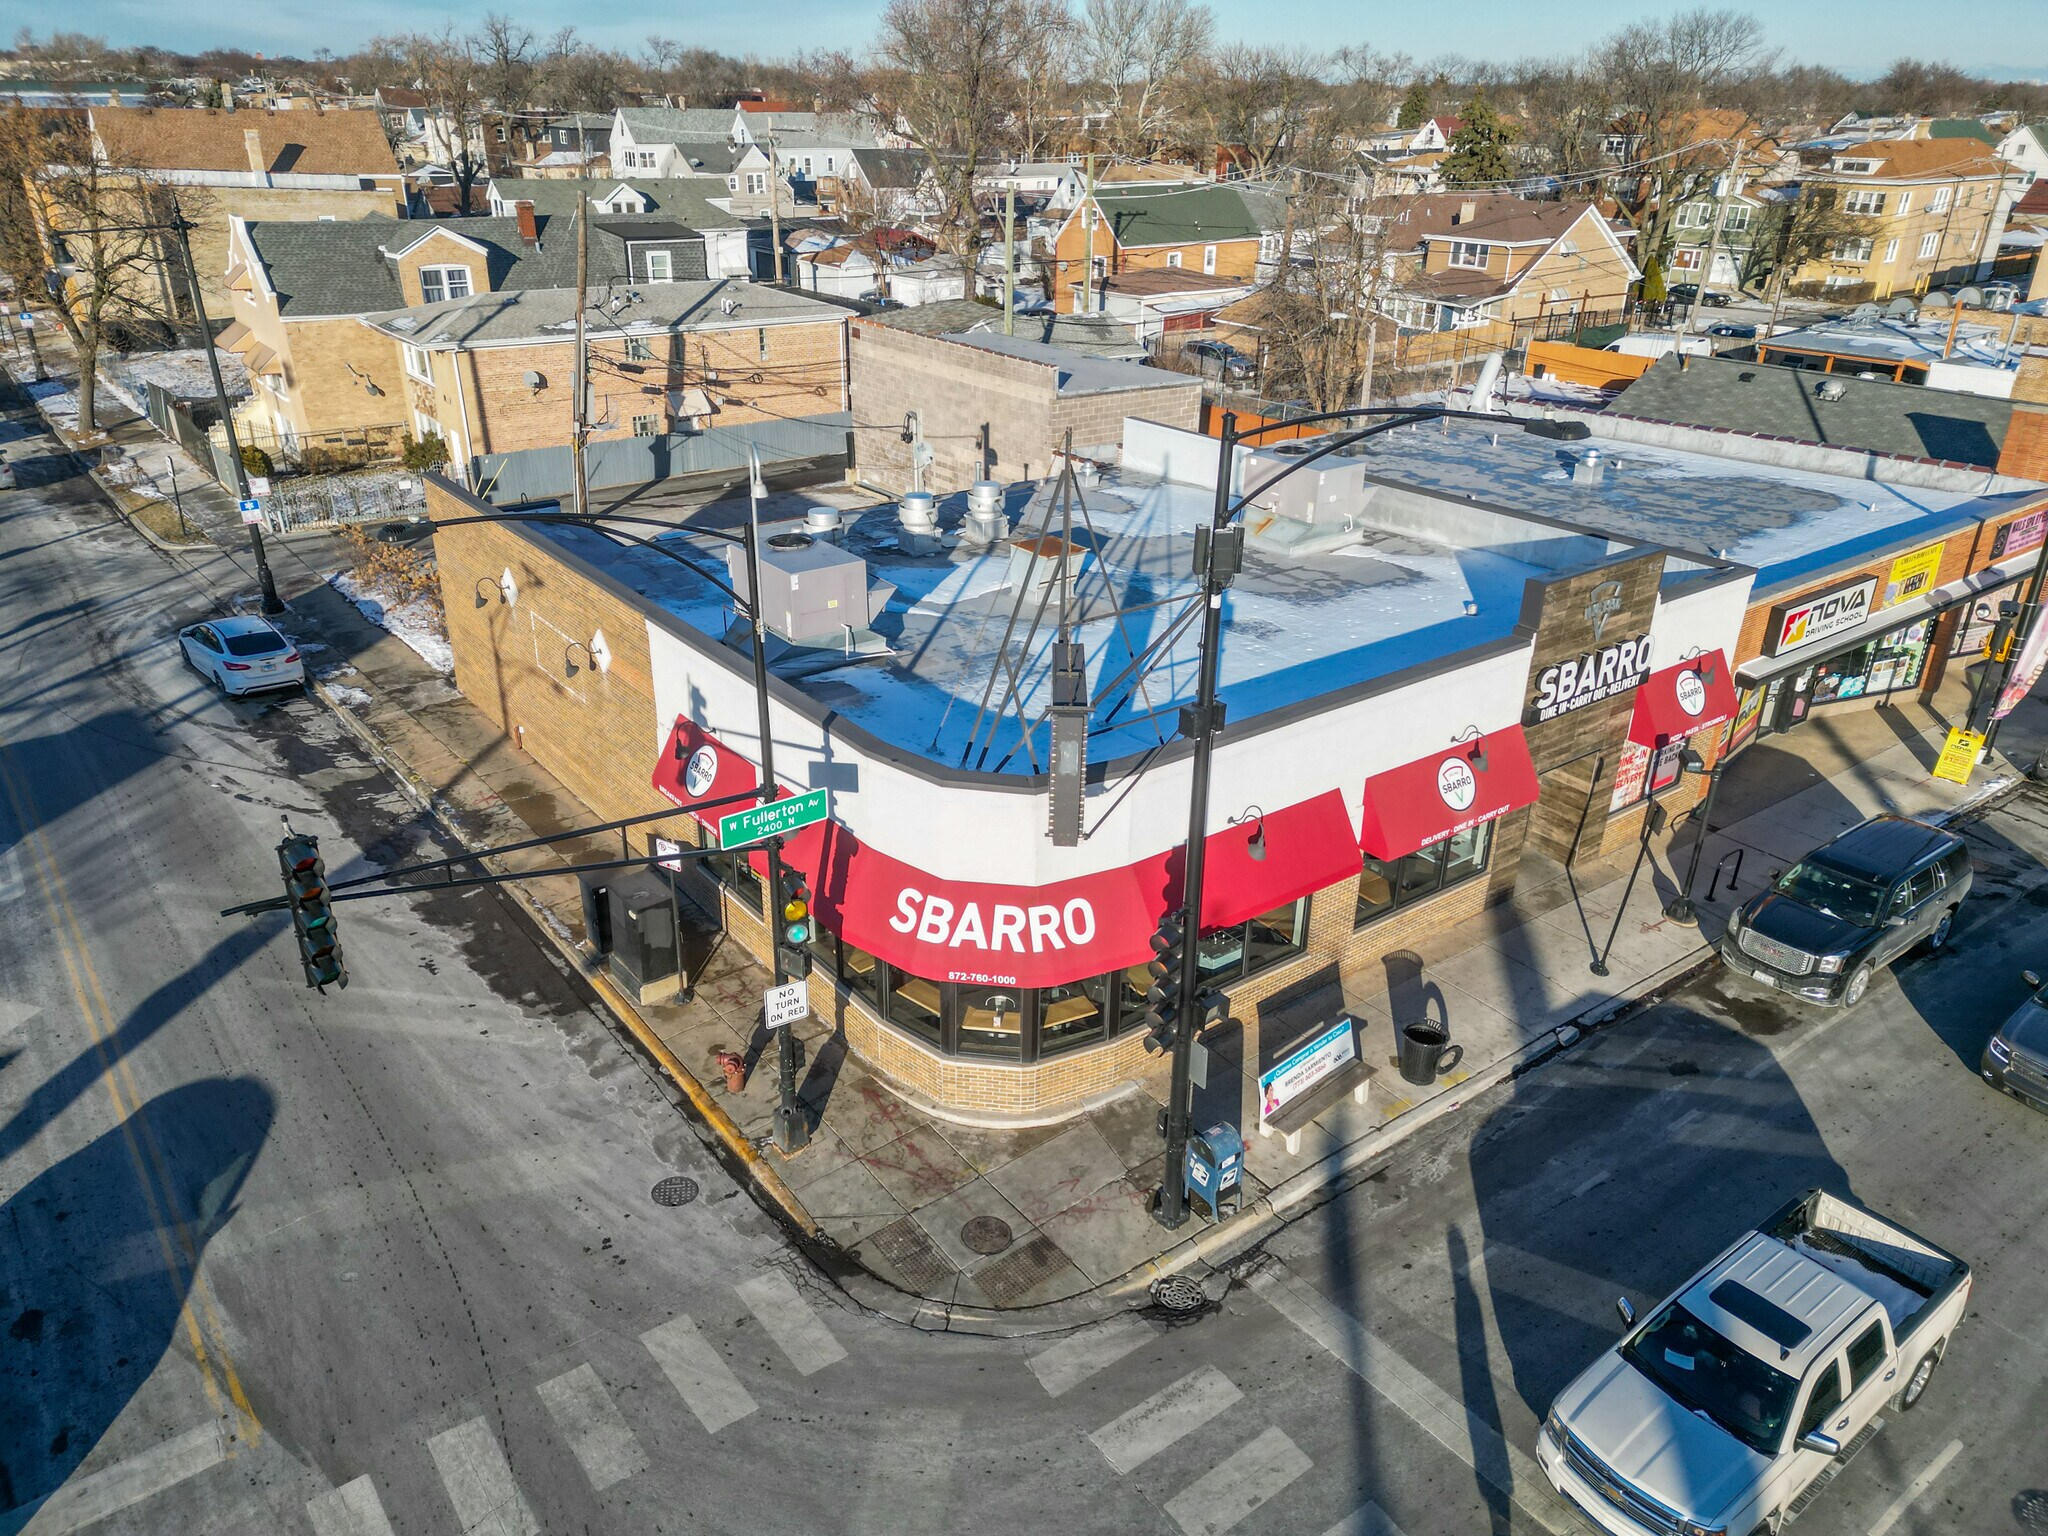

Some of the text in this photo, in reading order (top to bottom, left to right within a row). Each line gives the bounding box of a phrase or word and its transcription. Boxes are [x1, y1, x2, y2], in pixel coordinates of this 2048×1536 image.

[1806, 611, 1862, 638] DRIVING SCHOOL
[1536, 634, 1655, 709] SBARRO
[1540, 674, 1640, 721] DINE IN CARRY OUT DELIVERY
[1680, 686, 1702, 700] SBARRO
[1685, 726, 1698, 736] PASTA
[1702, 714, 1727, 730] STROMBOLI
[690, 760, 712, 783] SBARRO
[1615, 772, 1642, 790] ELIVERY
[1442, 776, 1472, 794] SBARRO
[730, 798, 819, 831] W Fullerton Av
[1421, 830, 1450, 846] DELIVERY
[1454, 822, 1467, 832] DINE
[1478, 810, 1498, 822] CARRY
[1498, 804, 1510, 814] OUT
[757, 817, 795, 836] 2400 N
[888, 888, 1096, 953] SBARRO
[949, 972, 1016, 984] 872-760-1000
[776, 997, 800, 1010] TURN
[780, 988, 794, 998] NO
[770, 1006, 804, 1022] ON RED
[1284, 1070, 1304, 1088] BRENDA
[1304, 1052, 1332, 1073] SARMIENTO
